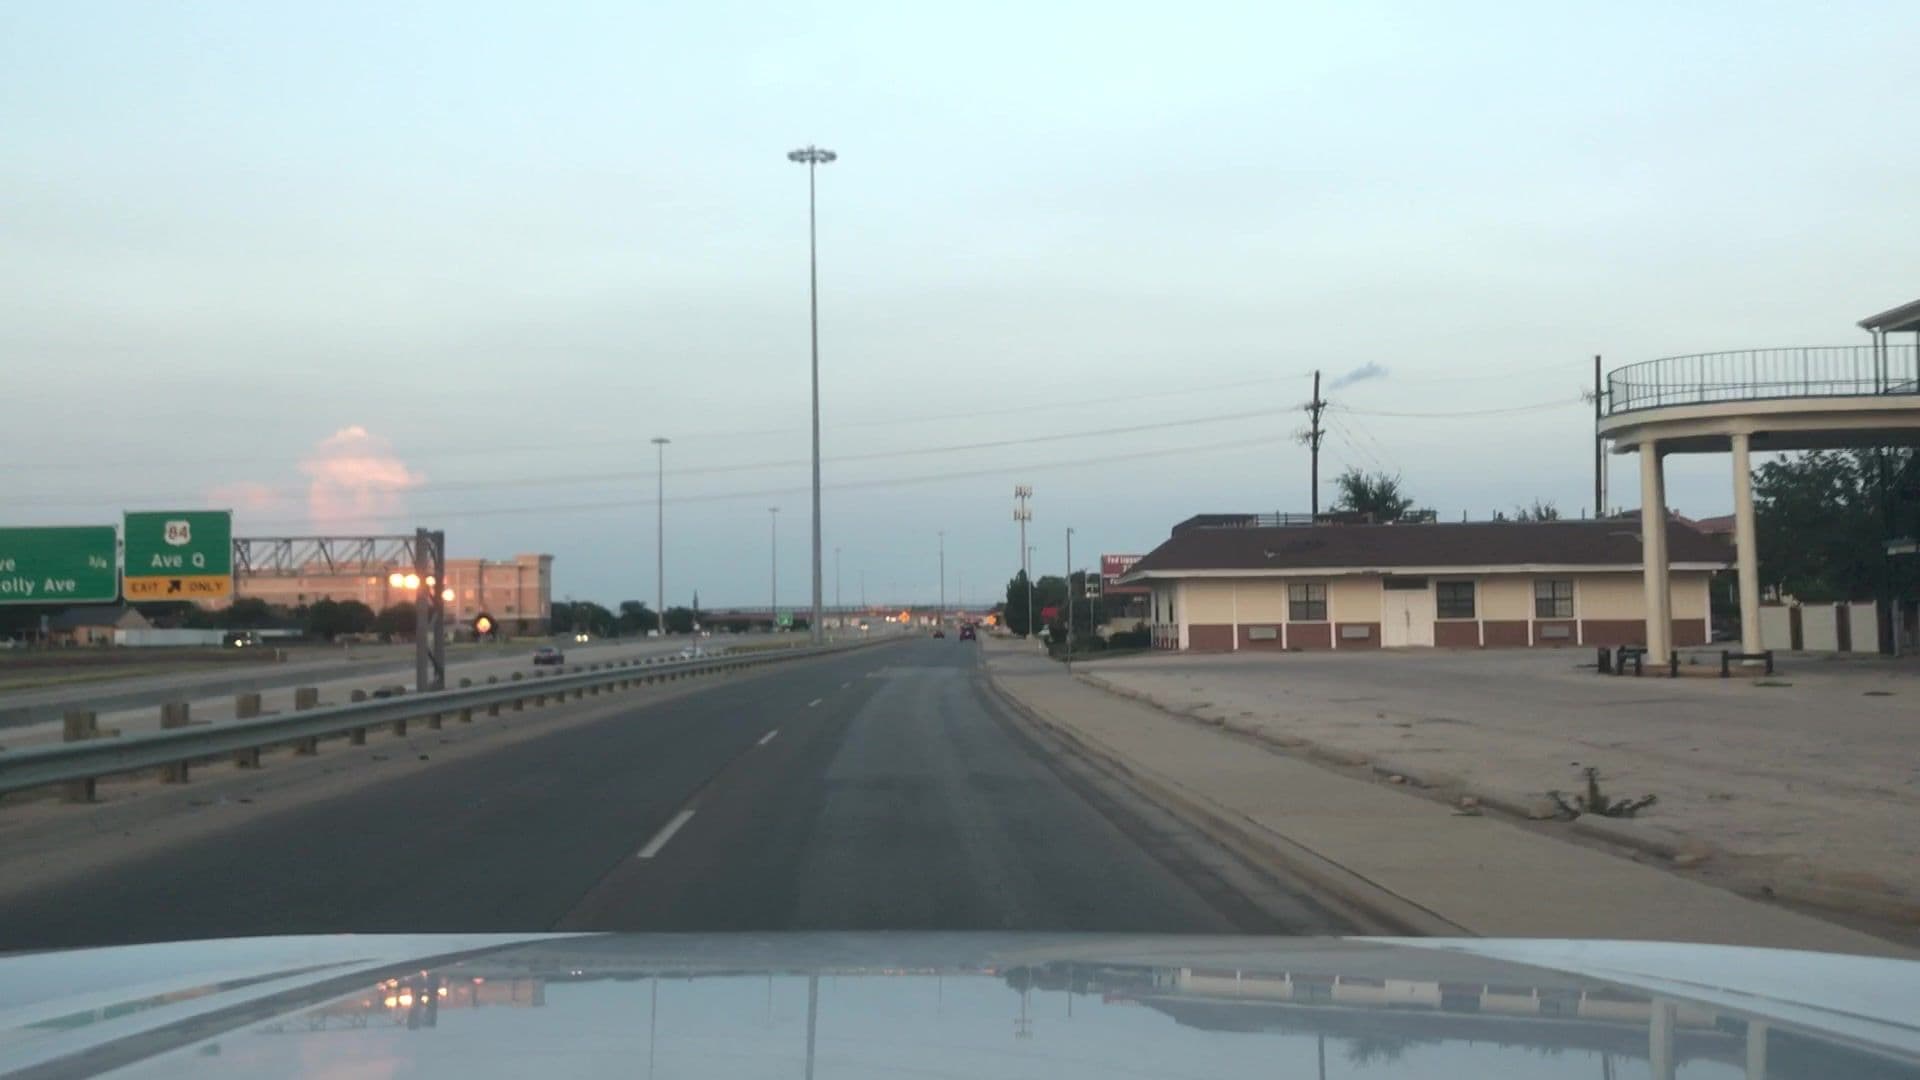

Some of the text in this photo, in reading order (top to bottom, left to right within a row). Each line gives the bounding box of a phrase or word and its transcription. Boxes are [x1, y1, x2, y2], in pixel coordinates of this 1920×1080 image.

[169, 525, 187, 539] 84
[152, 552, 205, 568] Ave Q
[44, 578, 76, 592] Ave
[131, 581, 224, 592] EXIT ONLY
